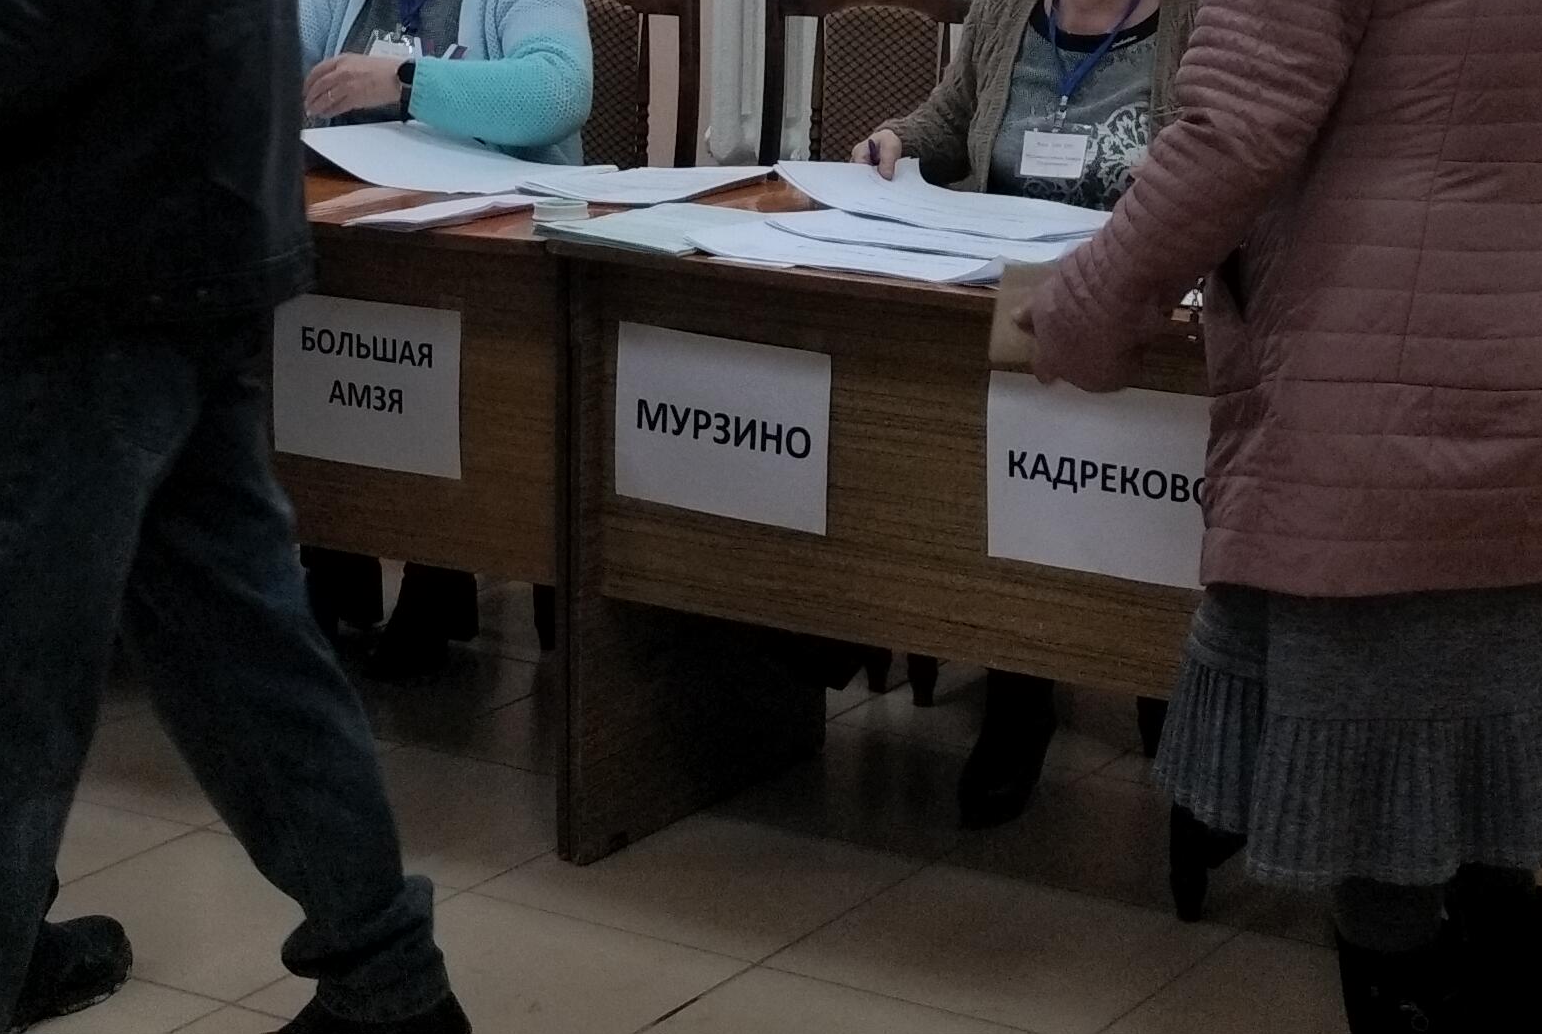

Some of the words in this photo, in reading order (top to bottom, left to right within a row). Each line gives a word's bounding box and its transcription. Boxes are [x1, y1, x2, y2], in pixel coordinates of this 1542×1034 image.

[301, 326, 433, 368] БОЛЬШАЯ
[328, 379, 403, 414] АМЗЯ
[636, 398, 811, 459] МУРЗИНО
